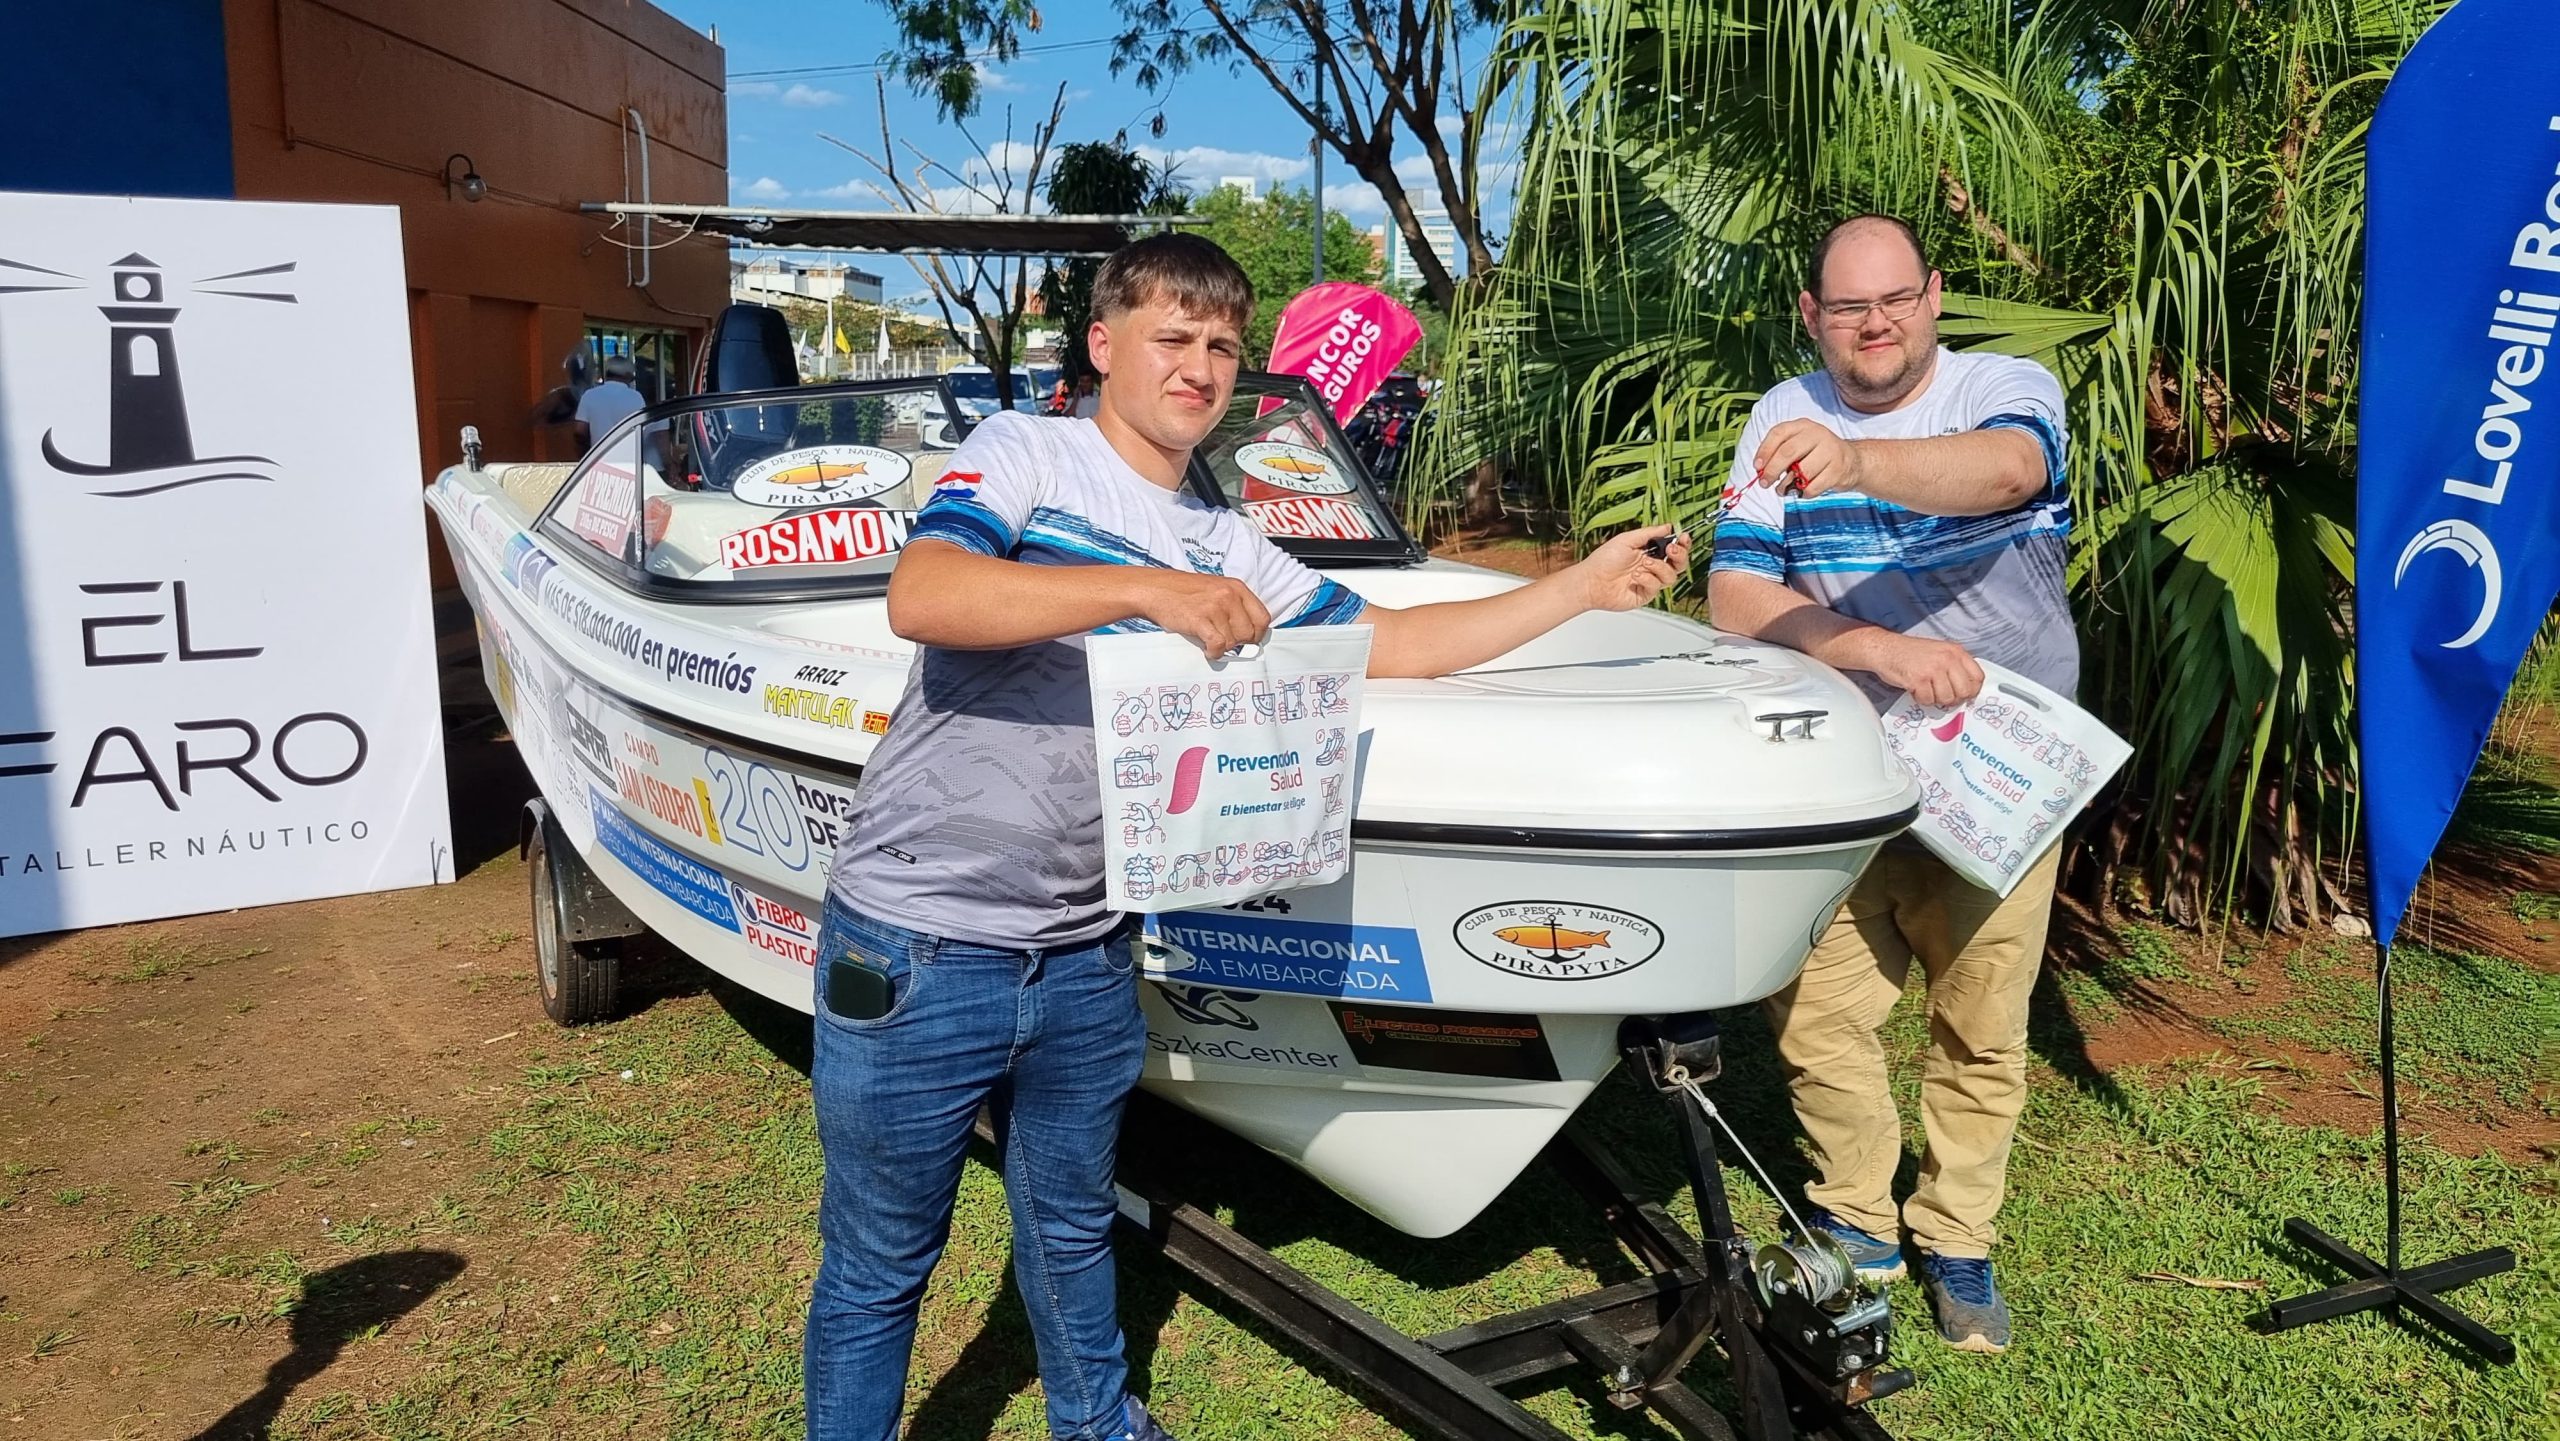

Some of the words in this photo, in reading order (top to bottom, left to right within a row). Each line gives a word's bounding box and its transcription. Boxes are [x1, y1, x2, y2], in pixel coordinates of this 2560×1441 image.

[1306, 308, 1363, 383] NCOR
[1324, 319, 1381, 403] GUROS
[2443, 288, 2560, 505] Lovelli
[740, 463, 766, 485] CLUB
[771, 456, 785, 466] DE
[791, 448, 828, 460] PESCA
[834, 447, 842, 455] Y
[848, 447, 899, 465] NAUTICA
[1268, 475, 1308, 490] PIRA
[767, 493, 820, 505] PIRA
[826, 481, 886, 502] PYTA
[79, 580, 265, 667] EL
[561, 591, 576, 624] DE
[574, 597, 642, 660] $18.000.000
[642, 639, 664, 669] en
[794, 665, 850, 686] ARROZ
[763, 684, 858, 729] MANTULAK
[624, 732, 659, 766] CAMPO
[1961, 733, 2033, 790] Prevención
[614, 757, 645, 809] SAN
[641, 772, 703, 837] ISIDRO
[791, 774, 851, 817] hora
[1270, 767, 1303, 791] Salud
[1982, 770, 2026, 803] Salud
[704, 744, 809, 872] 20
[1220, 805, 1231, 816] El
[1233, 802, 1282, 815] bienestar
[188, 821, 369, 858] NÁUTICO
[804, 815, 839, 850] DE
[637, 831, 730, 898] INTERNACIONAL
[663, 874, 737, 926] EMBARCADA
[755, 897, 807, 932] FIBRO
[1464, 912, 1495, 931] CLUB
[1500, 907, 1517, 917] DE
[1522, 906, 1566, 916] PESCA
[1573, 908, 1582, 917] Y
[1590, 911, 1650, 936] NAUTICA
[1154, 924, 1400, 965] INTERNACIONAL
[1224, 960, 1400, 992] EMBARCADA
[1491, 952, 1554, 975] PIRA
[1562, 957, 1628, 975] PYTA
[1385, 1031, 1437, 1041] CENTRO
[1443, 1025, 1538, 1038] POSADAS
[1147, 1032, 1339, 1069] SzkaCenter
